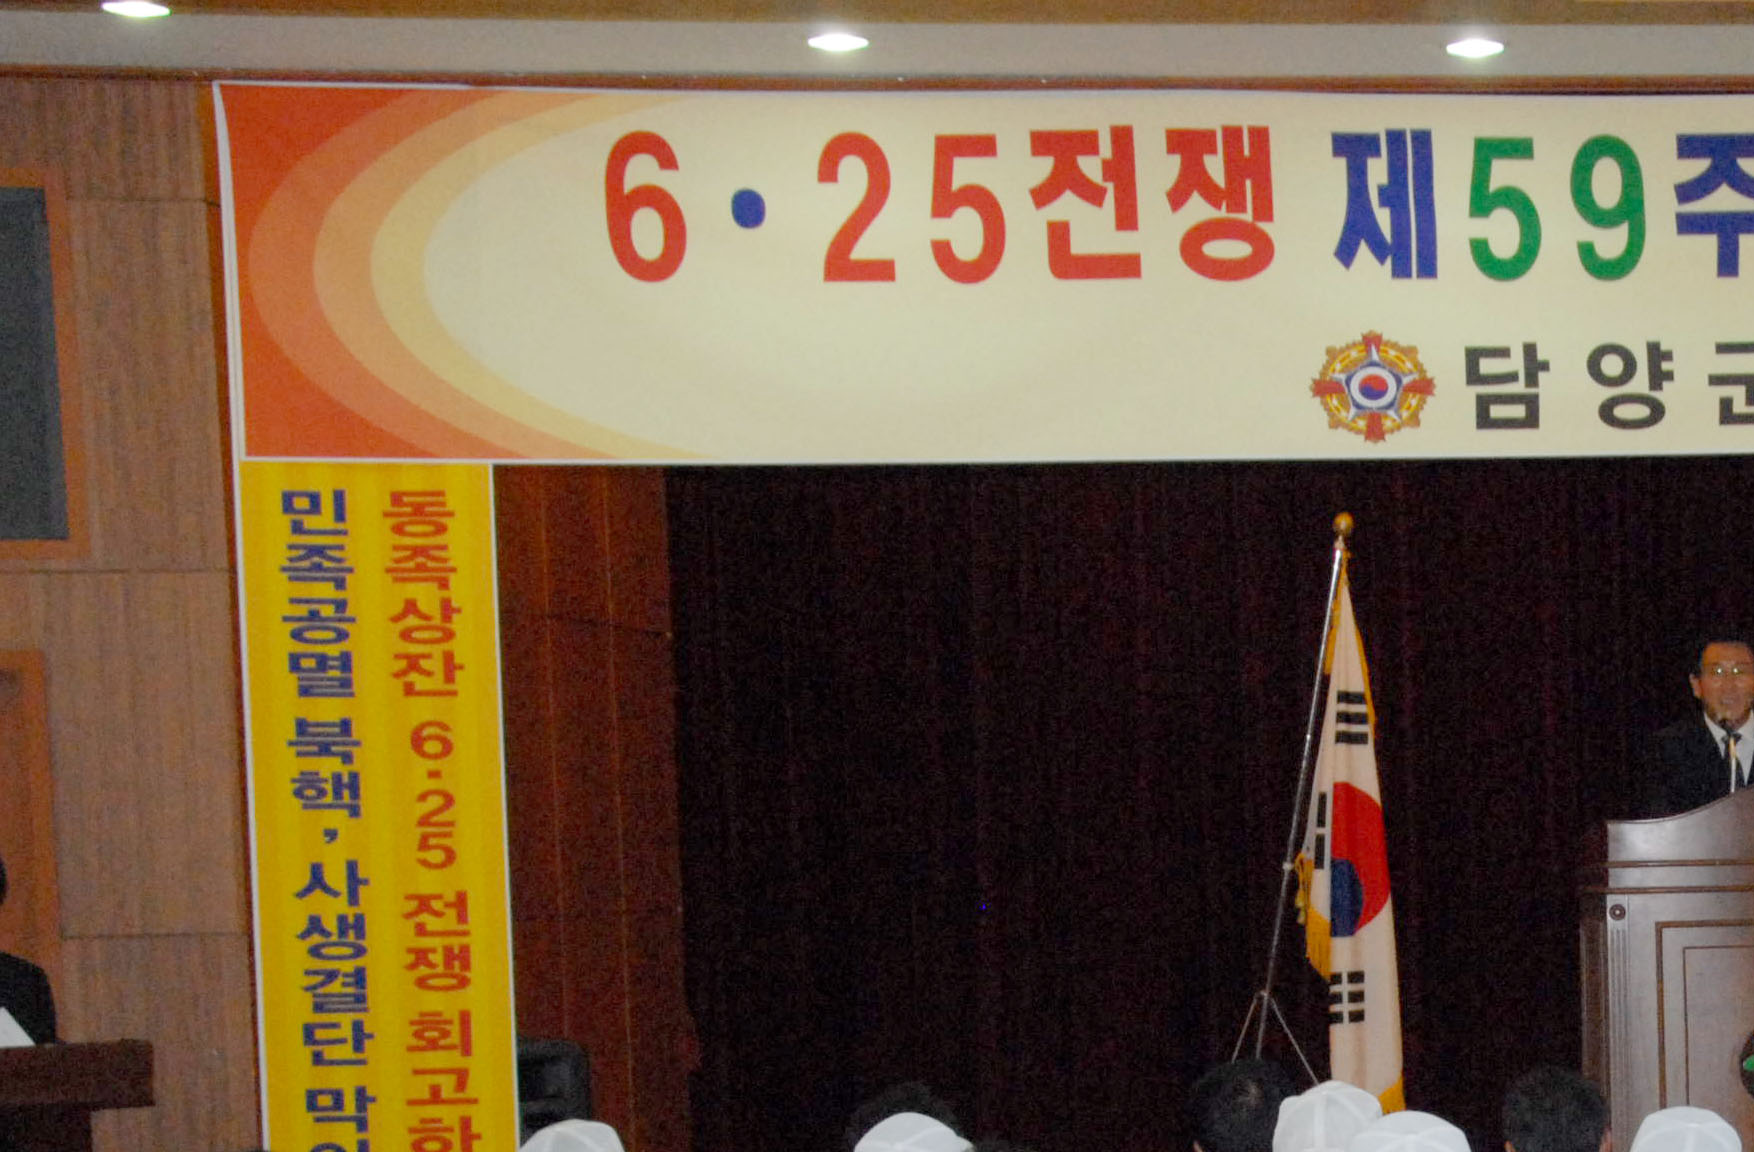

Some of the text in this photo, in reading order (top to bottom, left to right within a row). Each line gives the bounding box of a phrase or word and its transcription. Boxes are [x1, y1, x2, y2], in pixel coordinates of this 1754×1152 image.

[279, 488, 357, 699] 민족공멸
[382, 489, 465, 698] 동족상잔
[294, 859, 376, 1068] 사생결단
[401, 889, 471, 993] 전쟁
